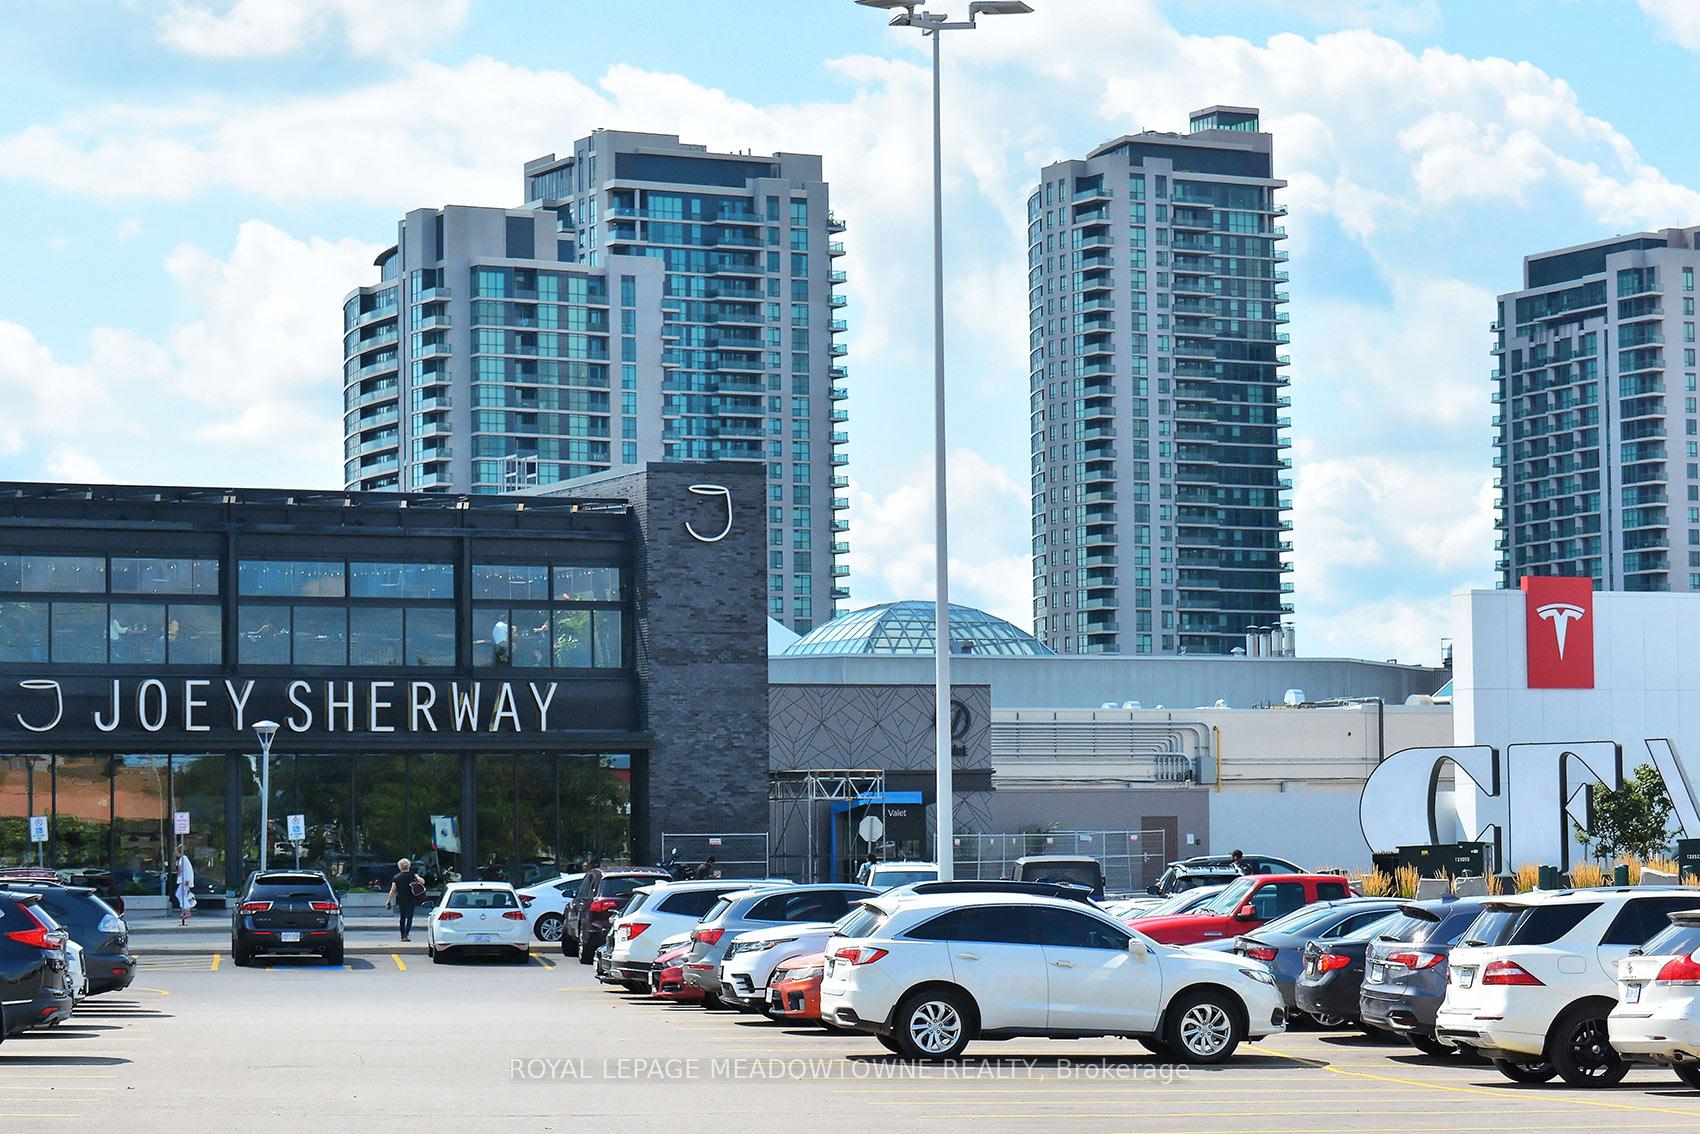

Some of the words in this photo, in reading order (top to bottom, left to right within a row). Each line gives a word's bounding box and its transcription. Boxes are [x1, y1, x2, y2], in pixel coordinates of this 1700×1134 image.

[93, 678, 256, 733] JOEY
[285, 680, 559, 734] SHERWAY
[887, 808, 908, 818] Valet
